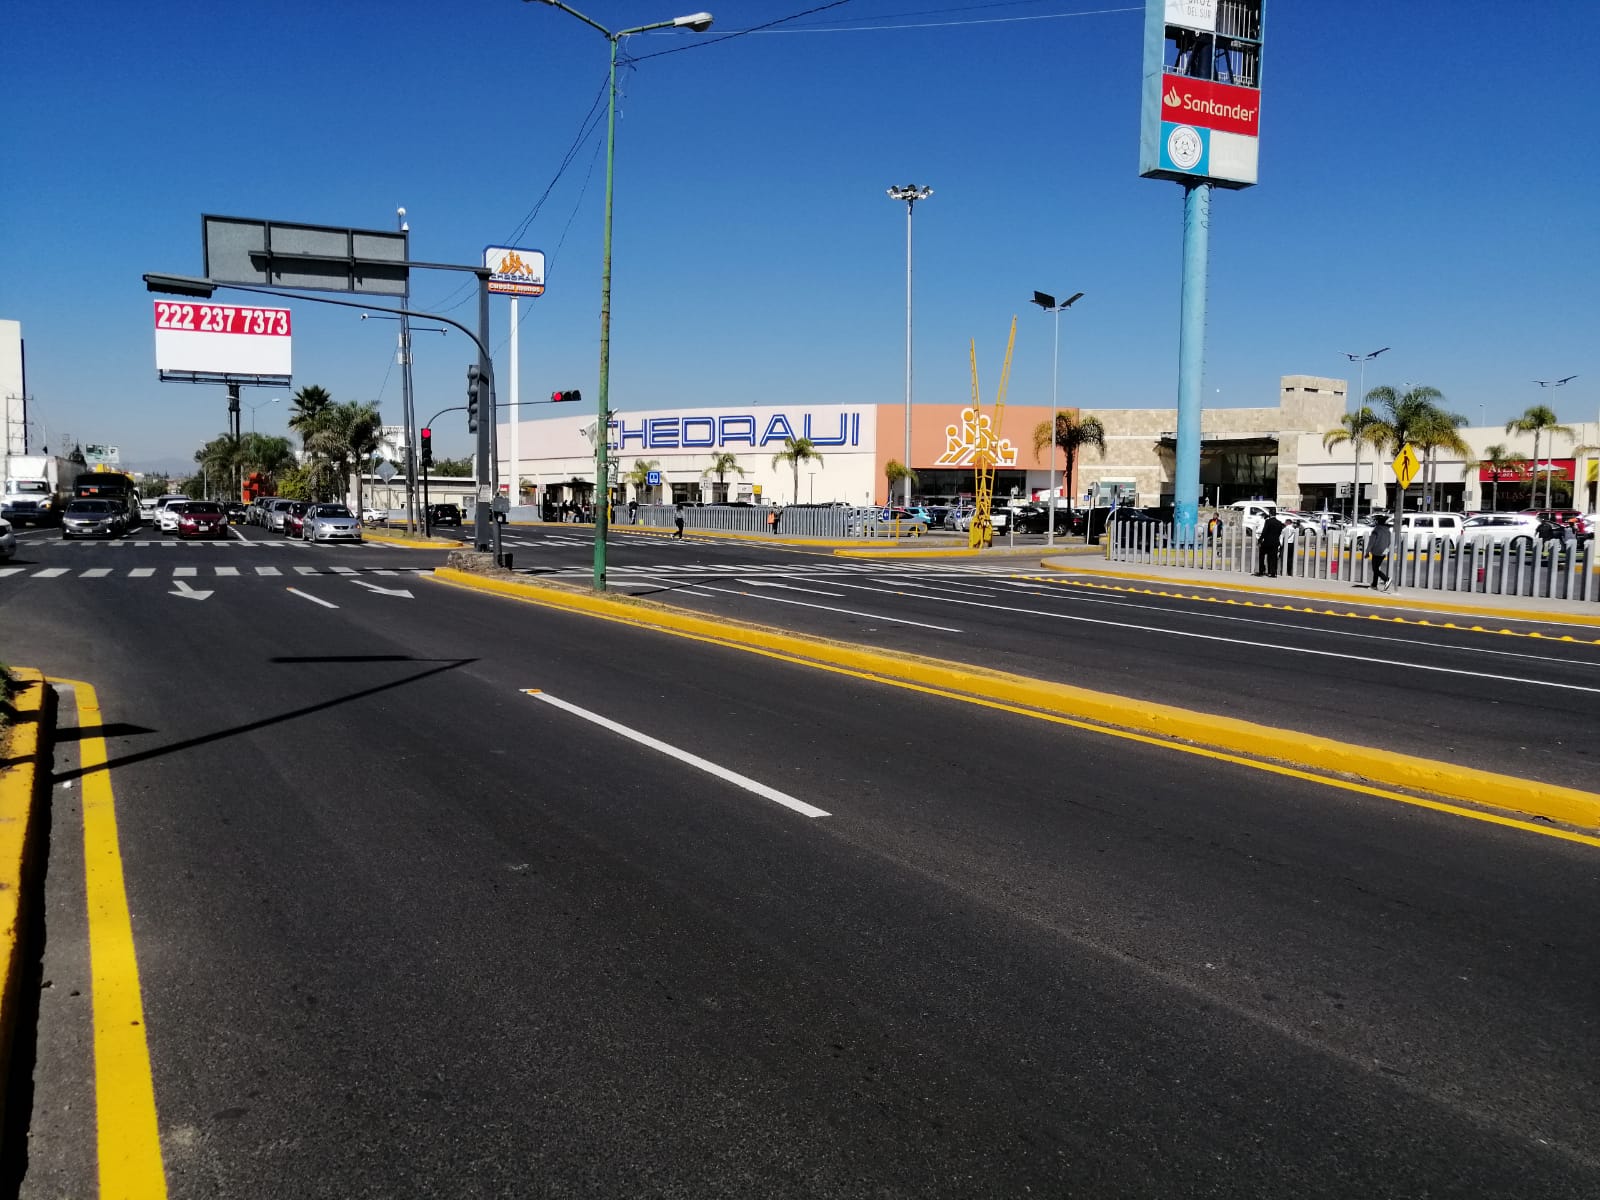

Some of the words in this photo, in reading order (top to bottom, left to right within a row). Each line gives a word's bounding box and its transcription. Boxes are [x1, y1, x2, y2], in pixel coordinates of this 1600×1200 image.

[1183, 93, 1255, 122] Santander
[157, 304, 195, 330] 222
[200, 307, 235, 332] 237
[241, 309, 288, 335] 7373
